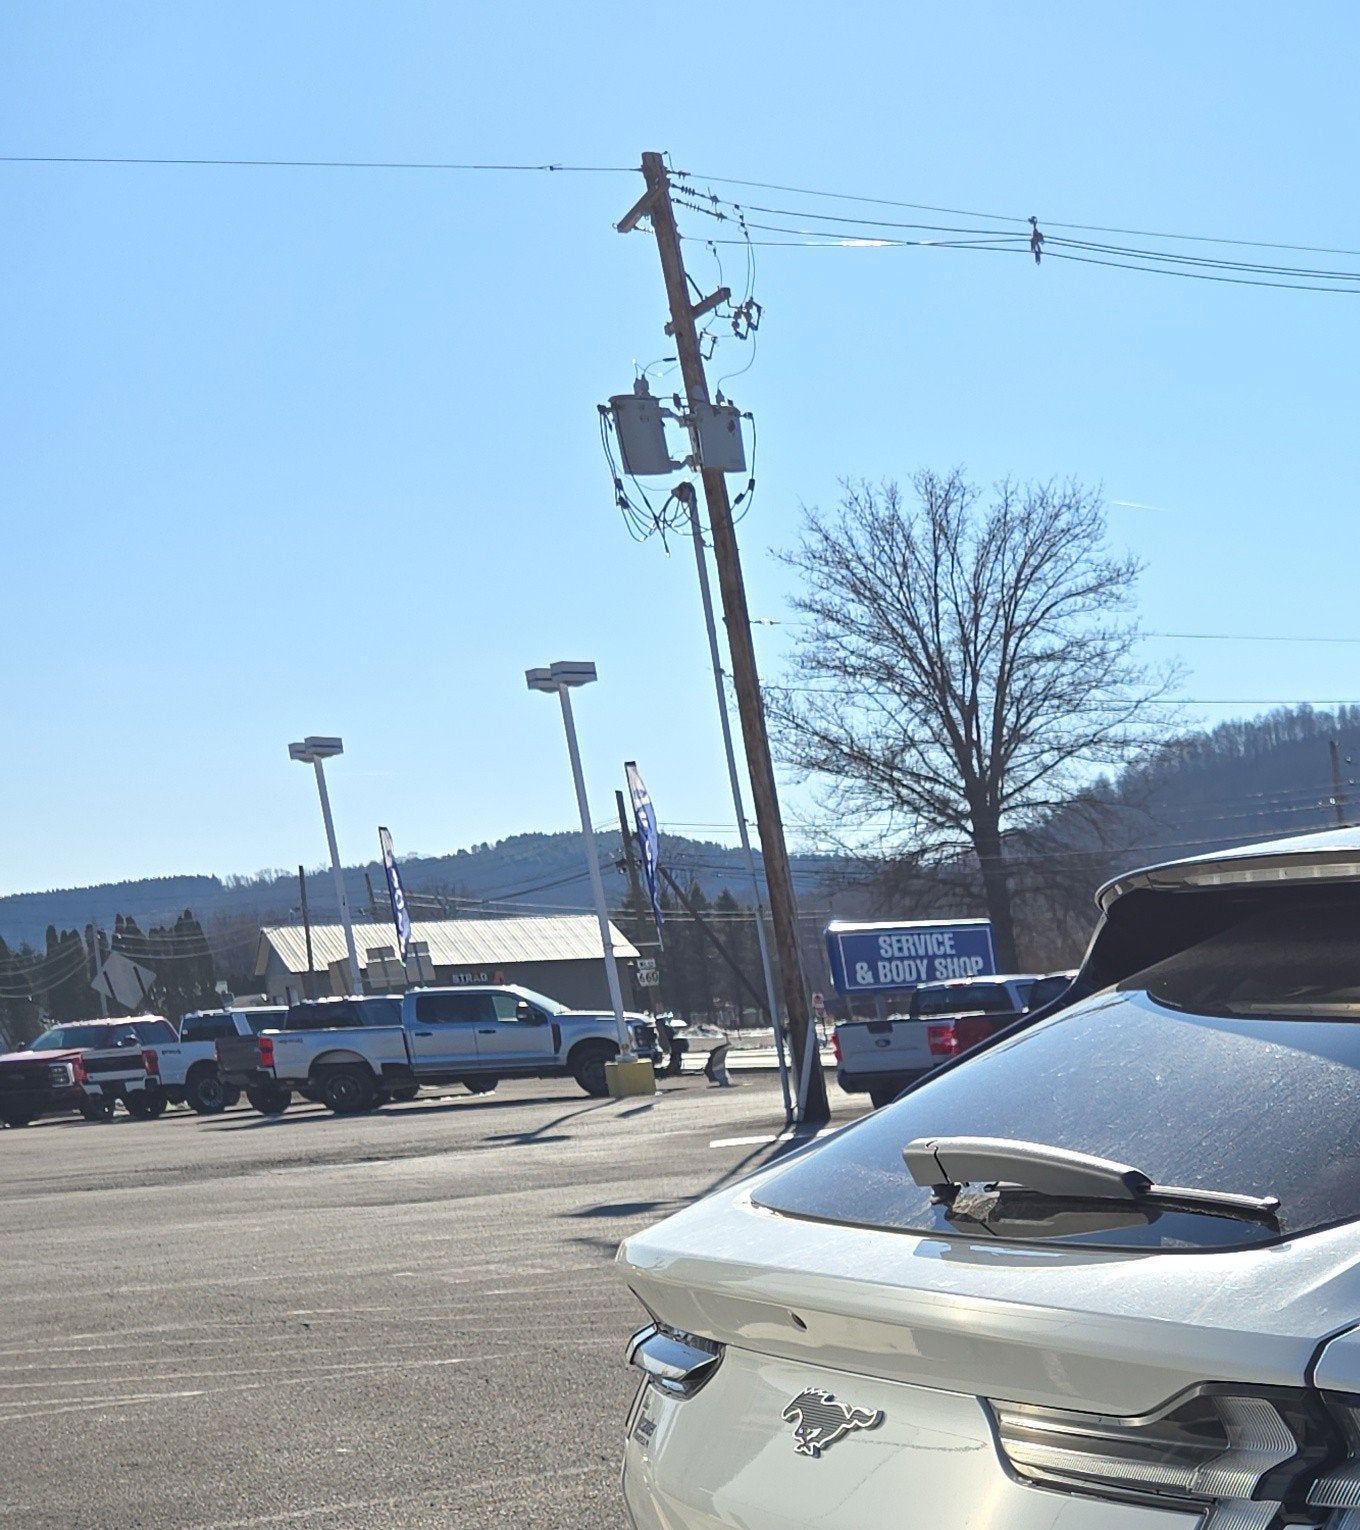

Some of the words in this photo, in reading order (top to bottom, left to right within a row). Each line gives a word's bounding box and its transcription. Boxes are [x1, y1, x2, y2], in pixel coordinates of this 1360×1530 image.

[878, 933, 956, 958] SERVICE
[855, 961, 875, 985] &
[877, 959, 928, 983] BODY
[934, 956, 984, 980] SHOP
